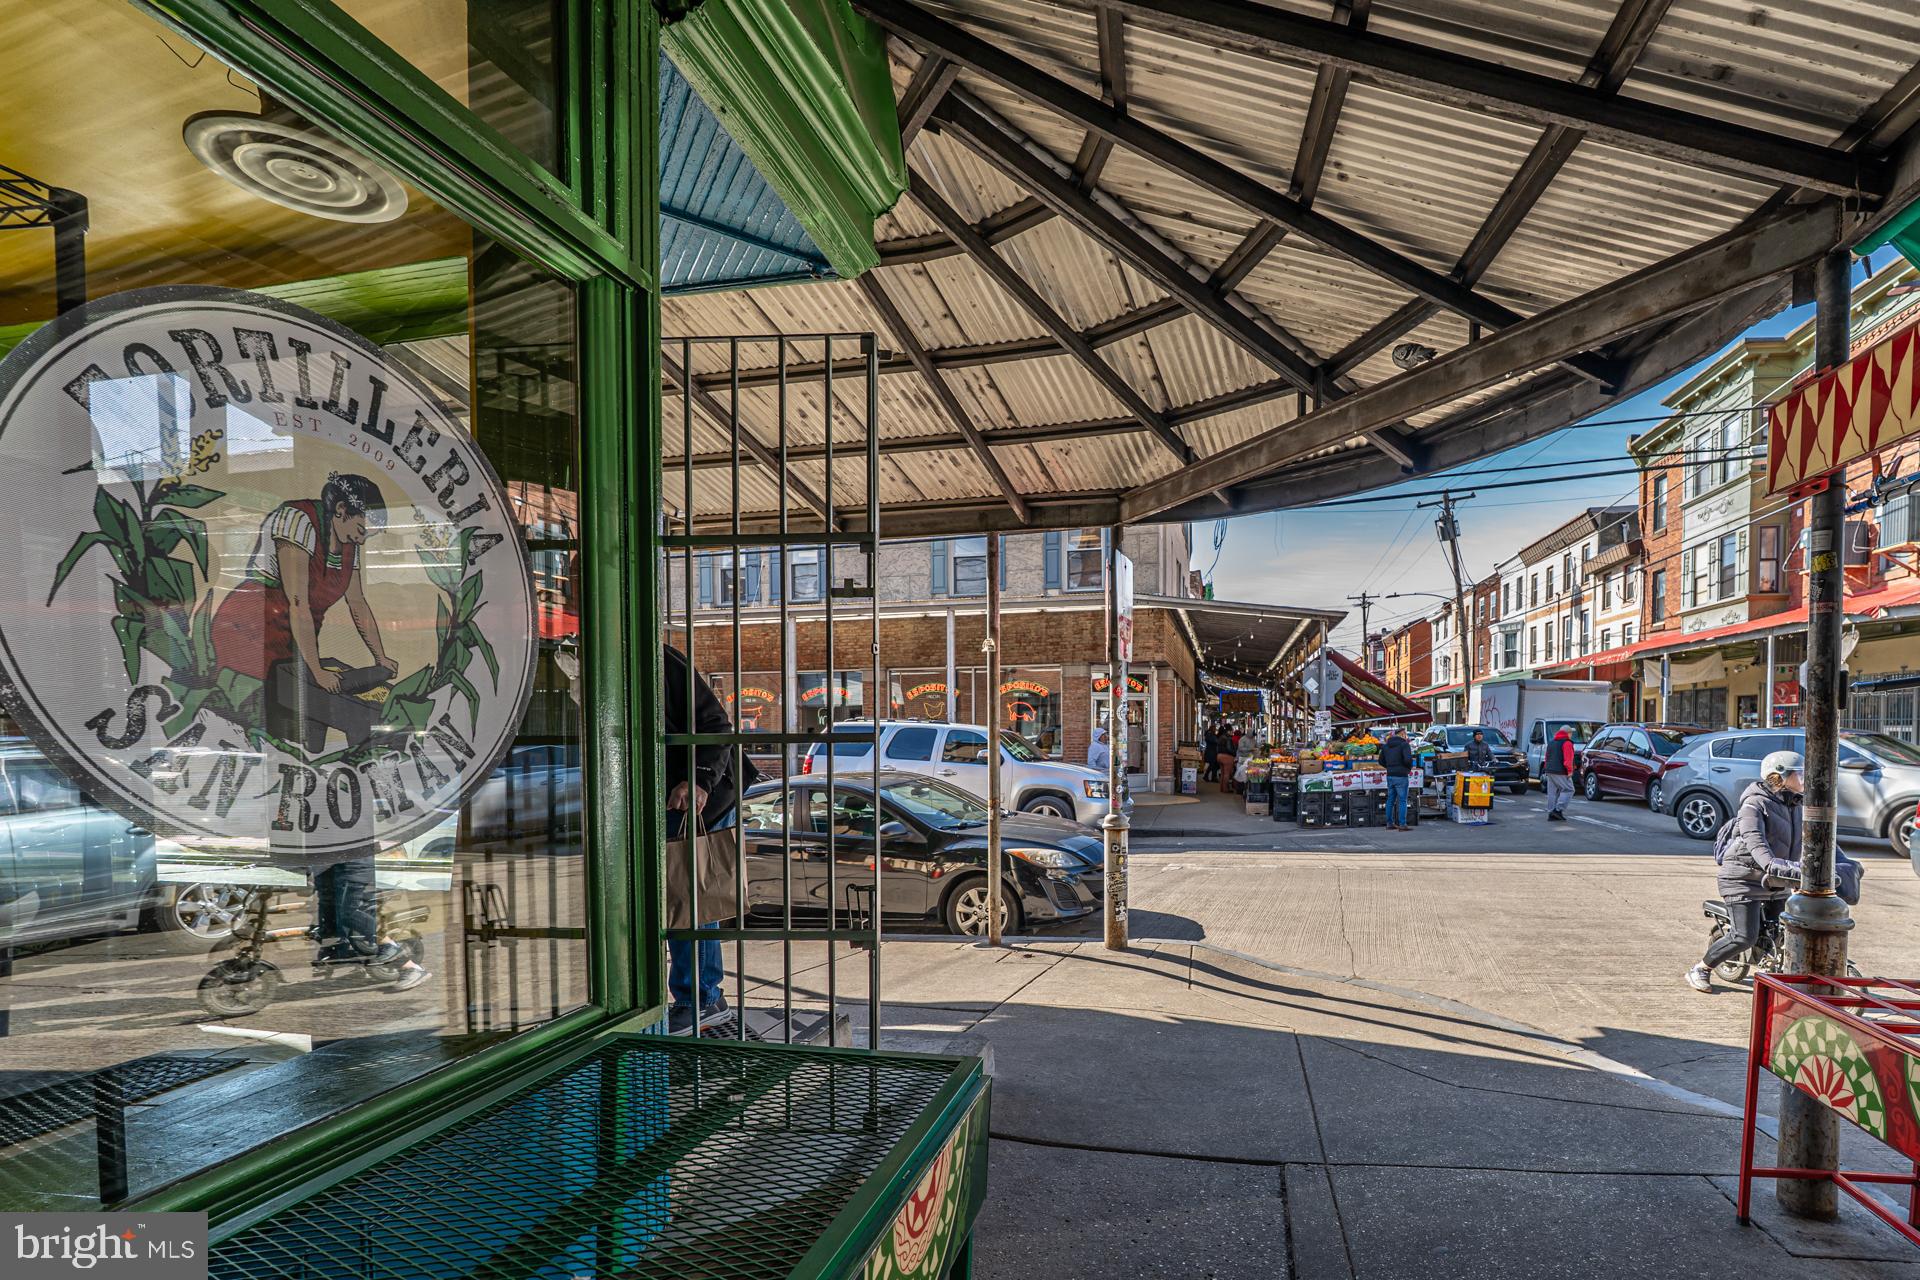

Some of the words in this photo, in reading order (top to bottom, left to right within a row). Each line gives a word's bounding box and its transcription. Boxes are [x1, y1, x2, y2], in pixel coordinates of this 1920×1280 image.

[348, 433, 396, 471] 2009
[726, 688, 775, 703] ESOSITO'S
[906, 683, 961, 700] ESPOSIT'S
[1000, 680, 1049, 697] SPOSITO'S
[84, 684, 262, 818] SAN
[271, 712, 476, 833] ROMAN
